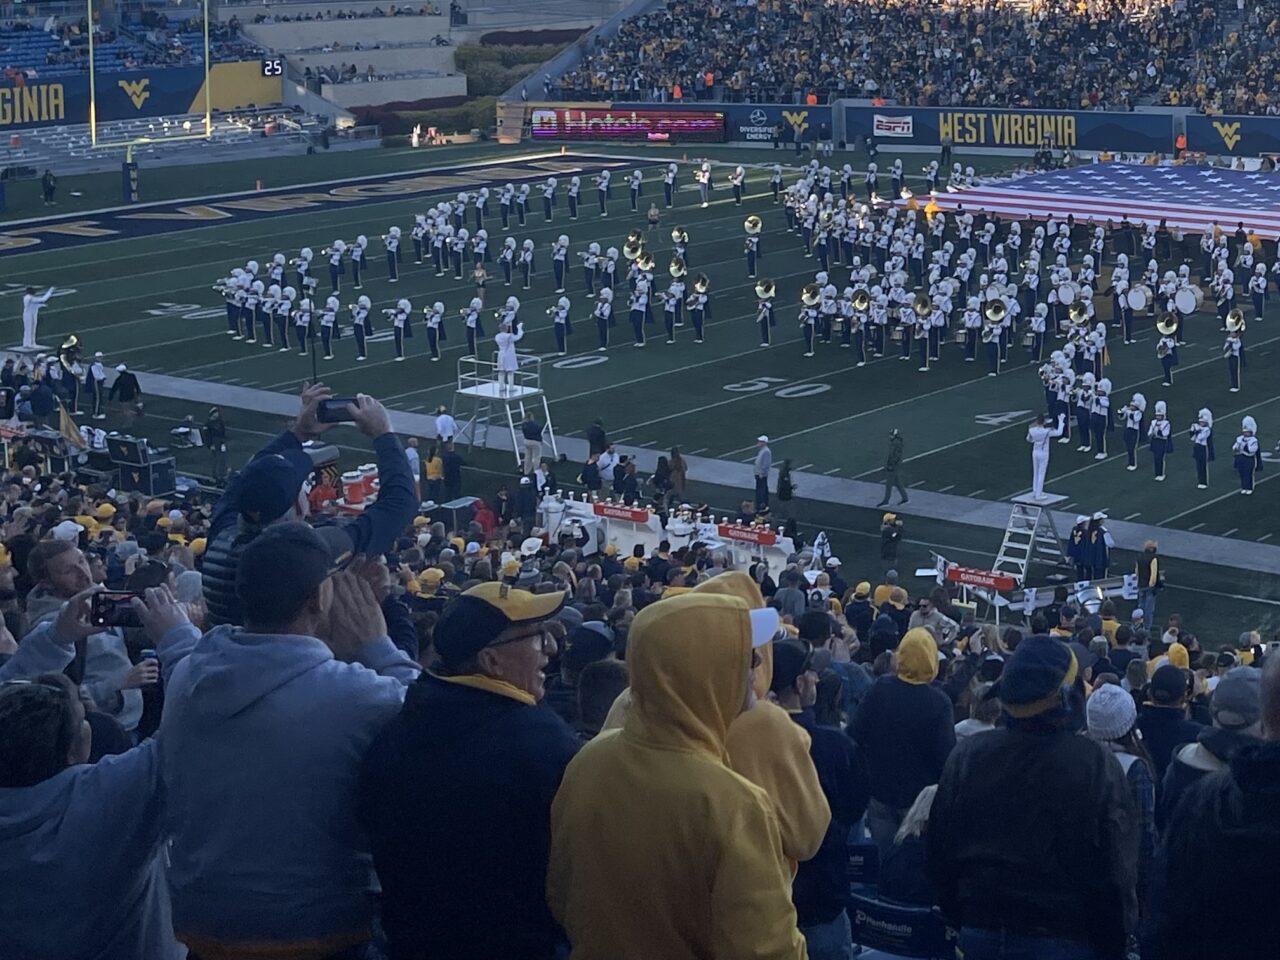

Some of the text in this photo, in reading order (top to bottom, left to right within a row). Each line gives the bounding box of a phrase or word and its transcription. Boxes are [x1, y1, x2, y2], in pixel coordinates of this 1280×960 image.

[264, 60, 282, 76] 25
[0, 83, 65, 125] GINIA
[939, 112, 1076, 145] WEST VIRGINIA
[960, 573, 995, 586] GATORADE
